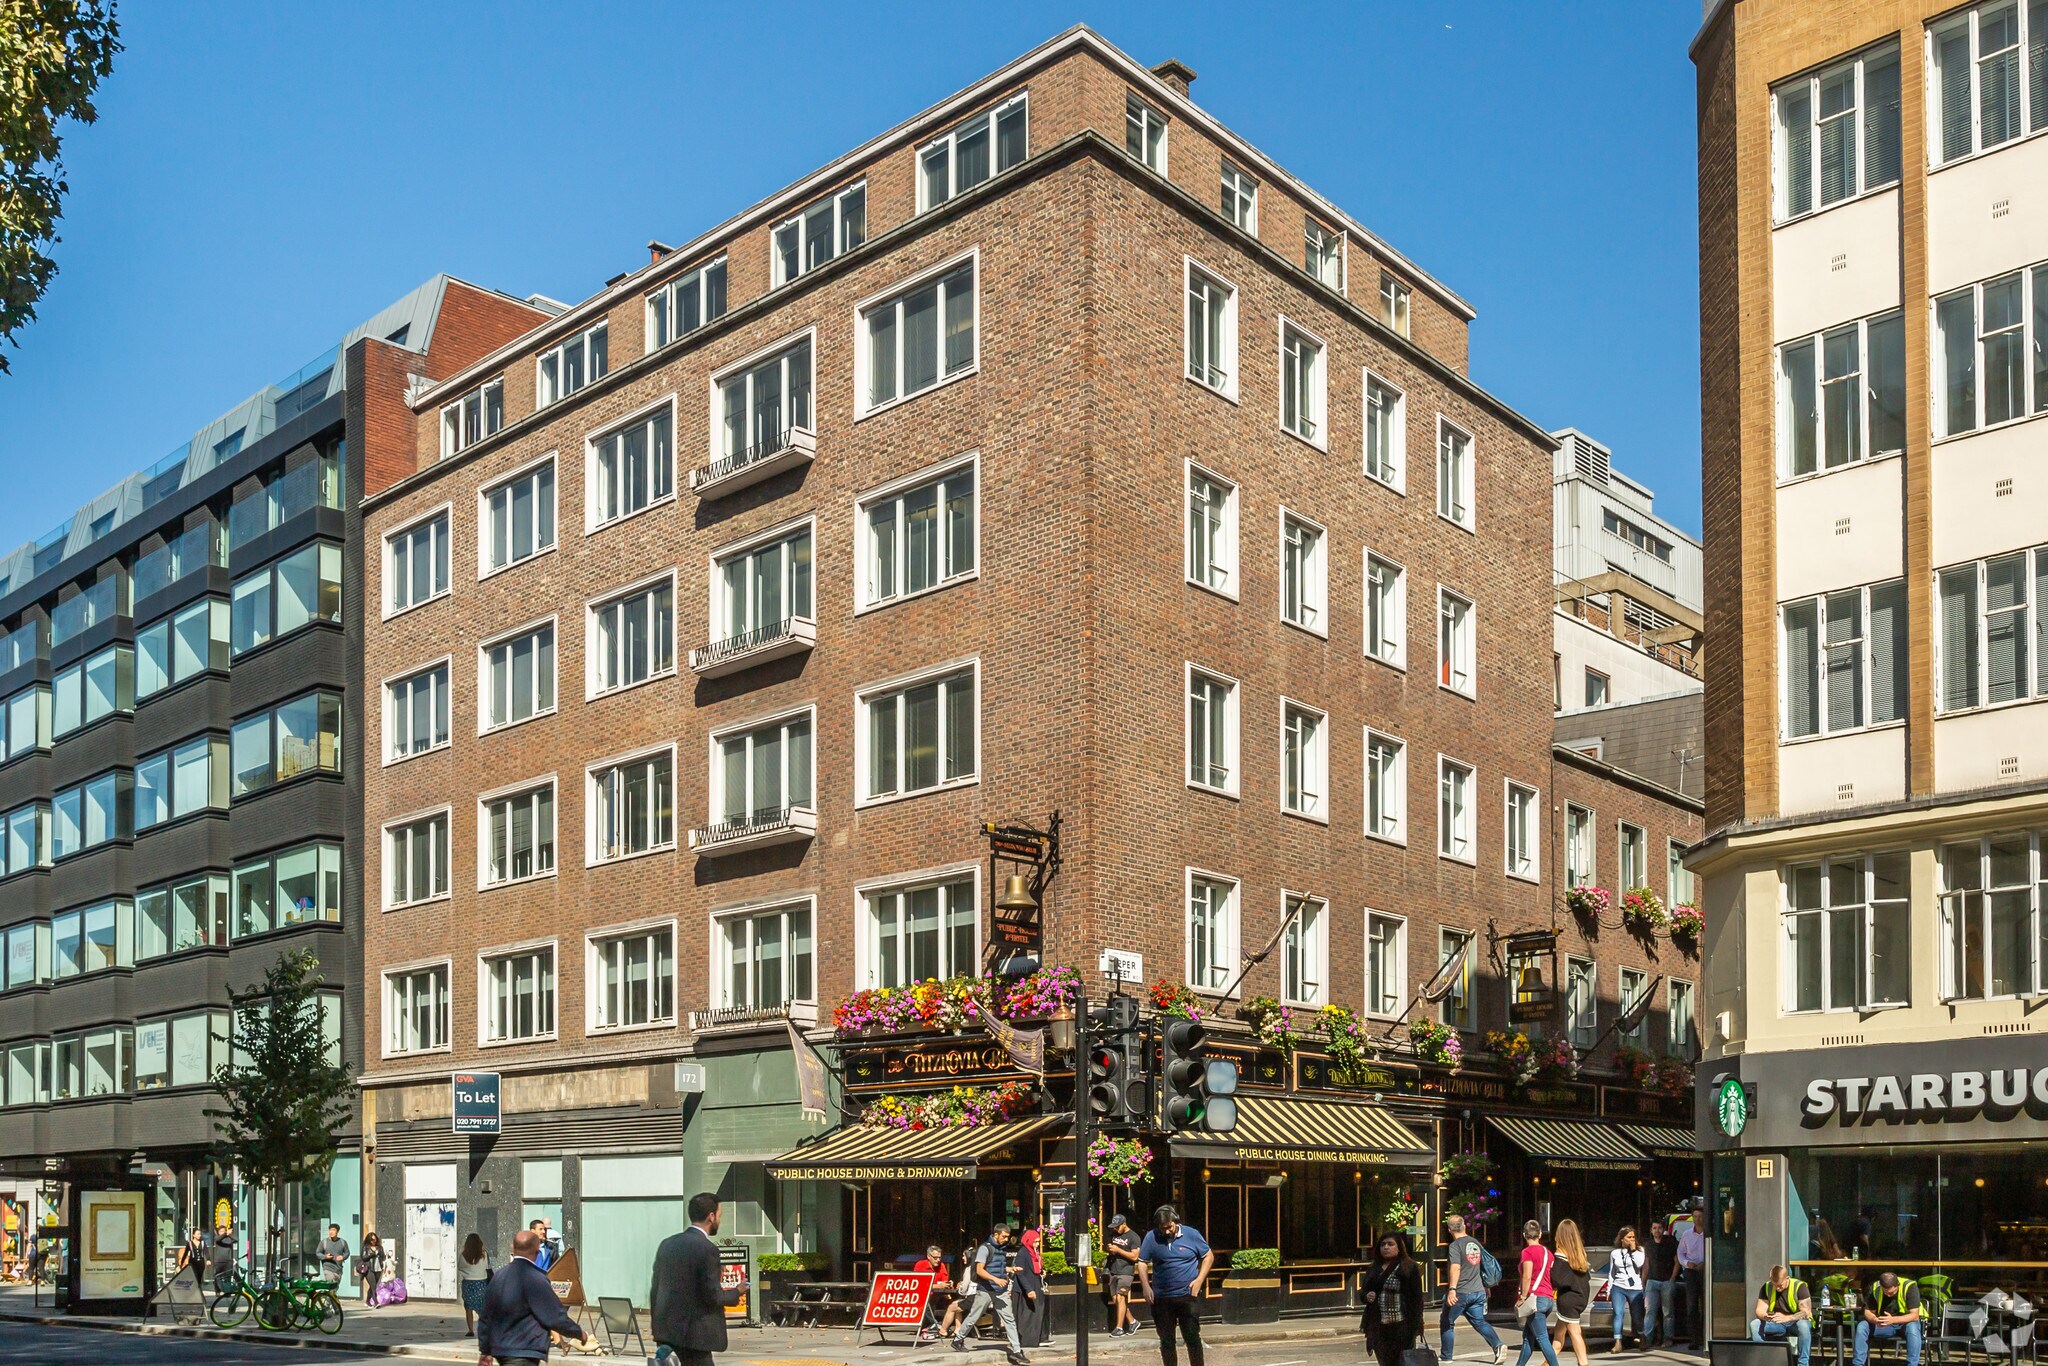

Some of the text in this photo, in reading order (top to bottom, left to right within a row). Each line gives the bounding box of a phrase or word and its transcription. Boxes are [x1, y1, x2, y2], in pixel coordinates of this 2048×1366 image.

[456, 1075, 474, 1083] GVA
[682, 1073, 697, 1084] 172
[456, 1091, 496, 1103] To Let
[1239, 1148, 1385, 1163] PUBLIC HOUSE DINING & DRINKING
[1548, 1159, 1568, 1168] PUBLIC
[1569, 1160, 1588, 1169] HOUSE
[1589, 1161, 1608, 1169] DINING
[1613, 1162, 1639, 1170] DRINKING
[777, 1167, 963, 1179] PUBLIC HOUSE DINING & DRINKING
[885, 1279, 919, 1290] ROAD
[878, 1293, 919, 1304] AHEAD
[872, 1306, 919, 1318] CLOSED
